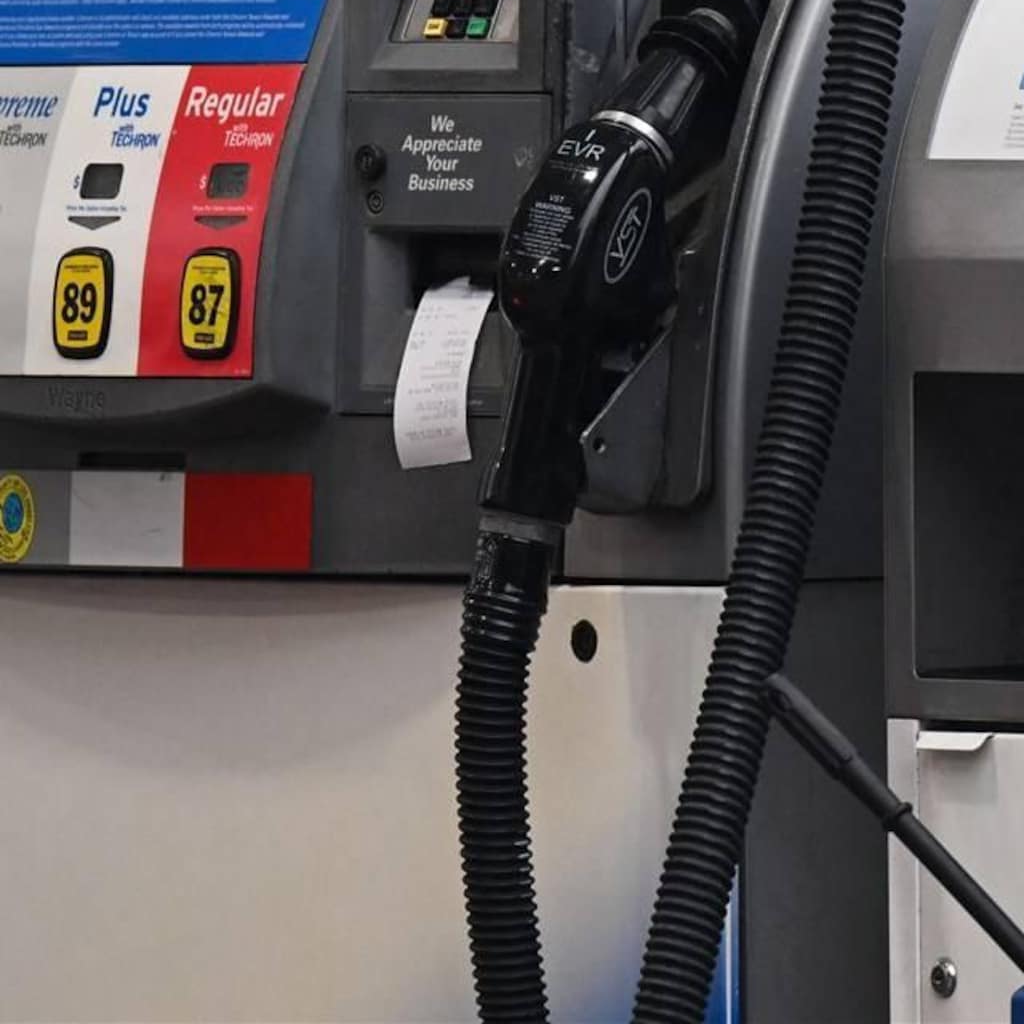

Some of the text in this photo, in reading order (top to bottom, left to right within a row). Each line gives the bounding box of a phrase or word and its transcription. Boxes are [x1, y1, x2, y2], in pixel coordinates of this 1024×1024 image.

[94, 86, 151, 117] Plus
[185, 85, 285, 124] Regular
[430, 114, 455, 133] We
[401, 135, 483, 154] Appreciate
[557, 139, 606, 162] EVR
[425, 154, 459, 172] Your
[408, 173, 475, 192] Business
[609, 205, 642, 269] VST
[61, 281, 98, 324] 89
[188, 284, 225, 327] 87
